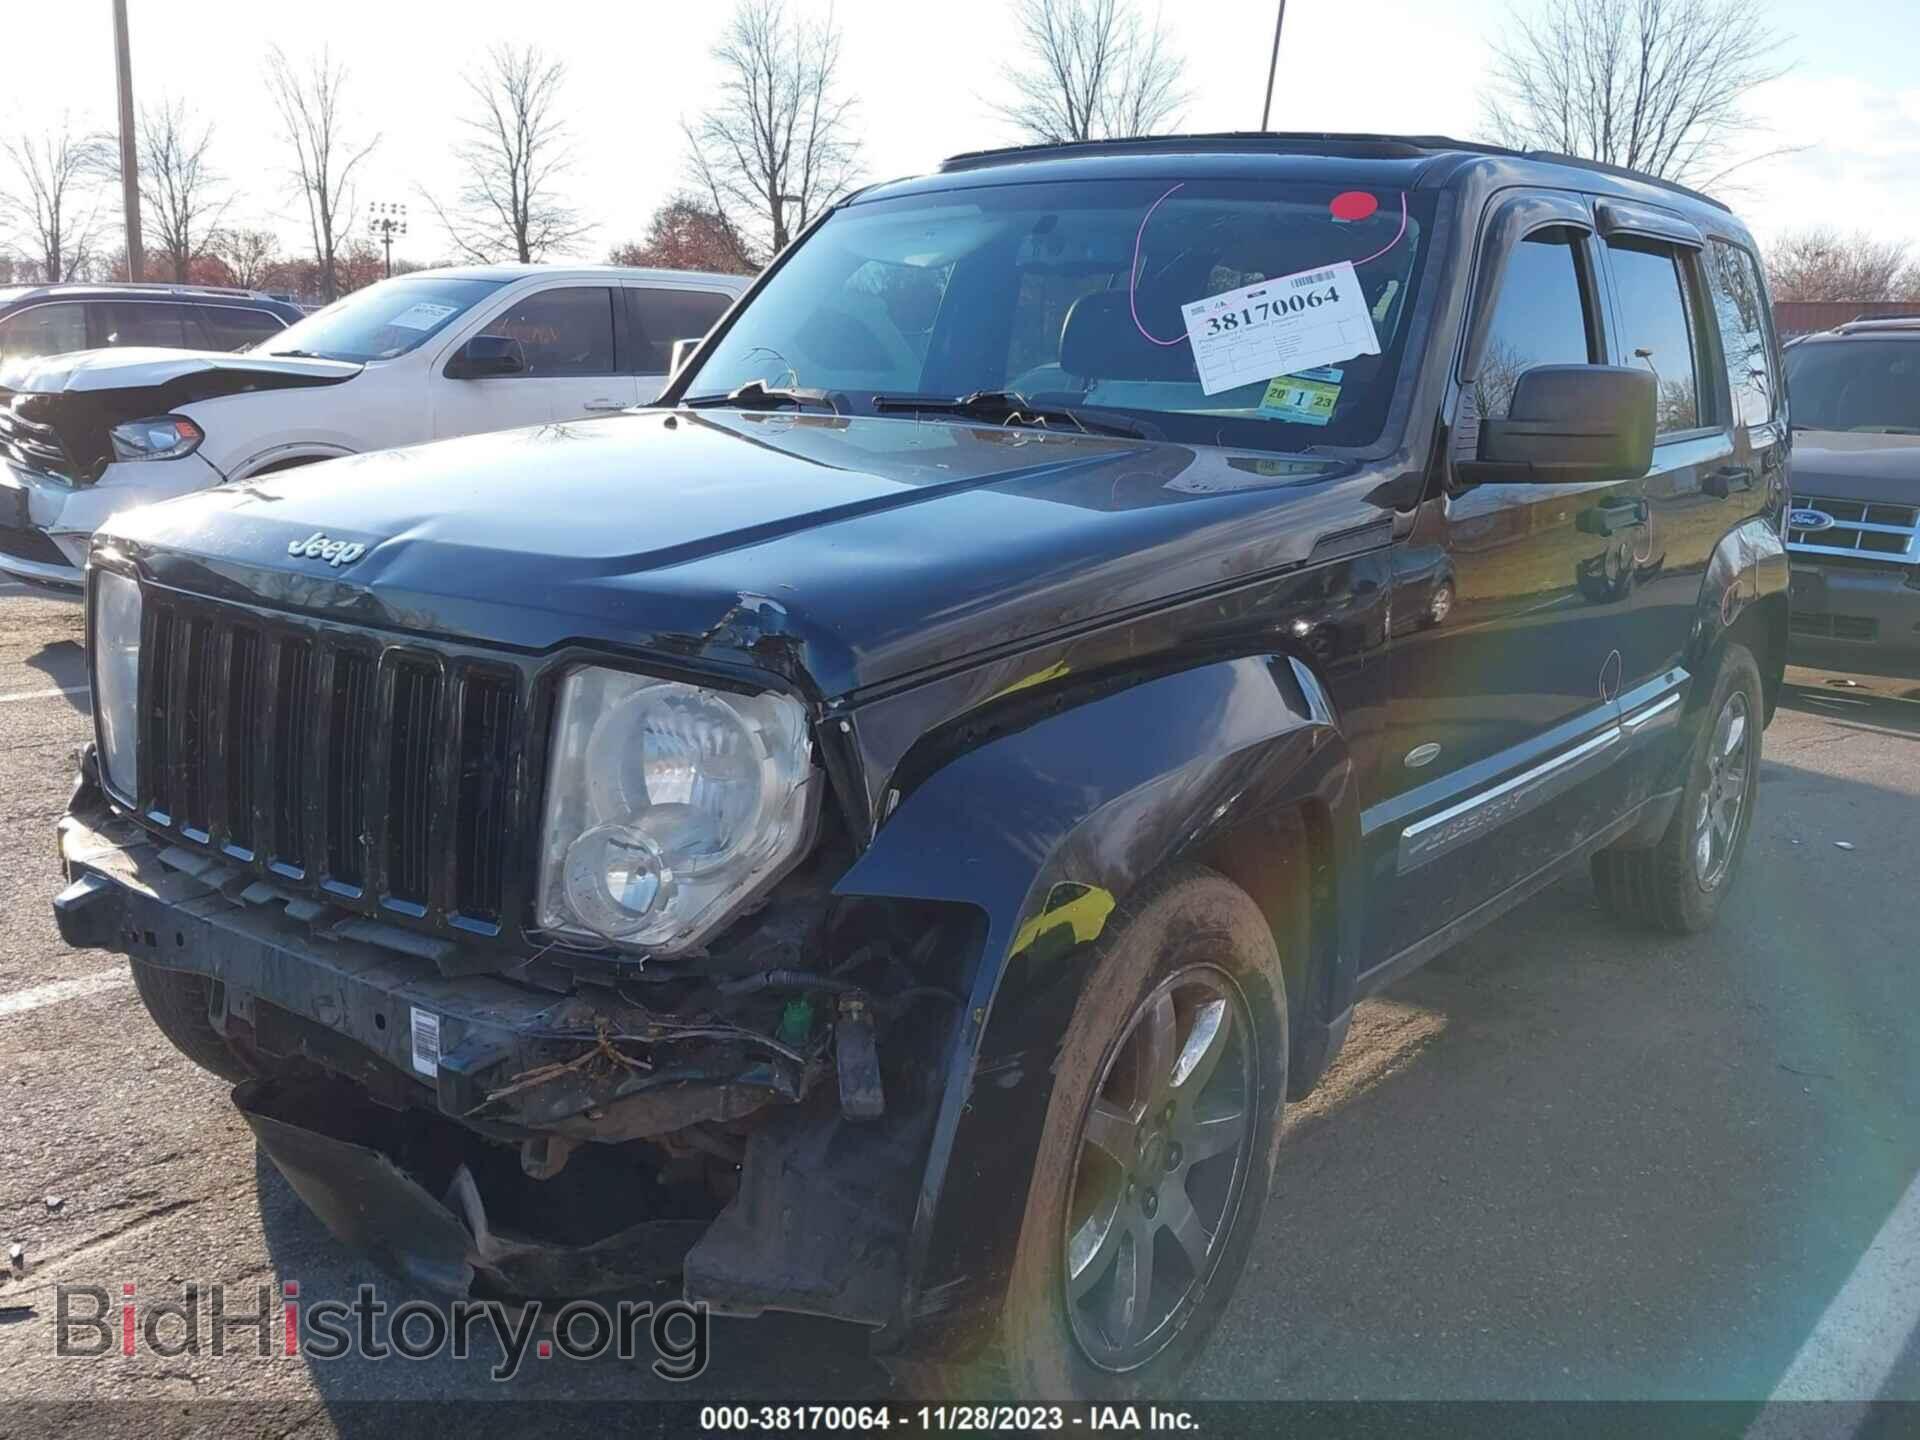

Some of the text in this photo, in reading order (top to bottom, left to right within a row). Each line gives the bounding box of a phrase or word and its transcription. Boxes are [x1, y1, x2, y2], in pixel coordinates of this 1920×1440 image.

[1207, 286, 1340, 336] 38170064
[1269, 388, 1332, 408] 20 1 23
[287, 532, 367, 567] Jeep
